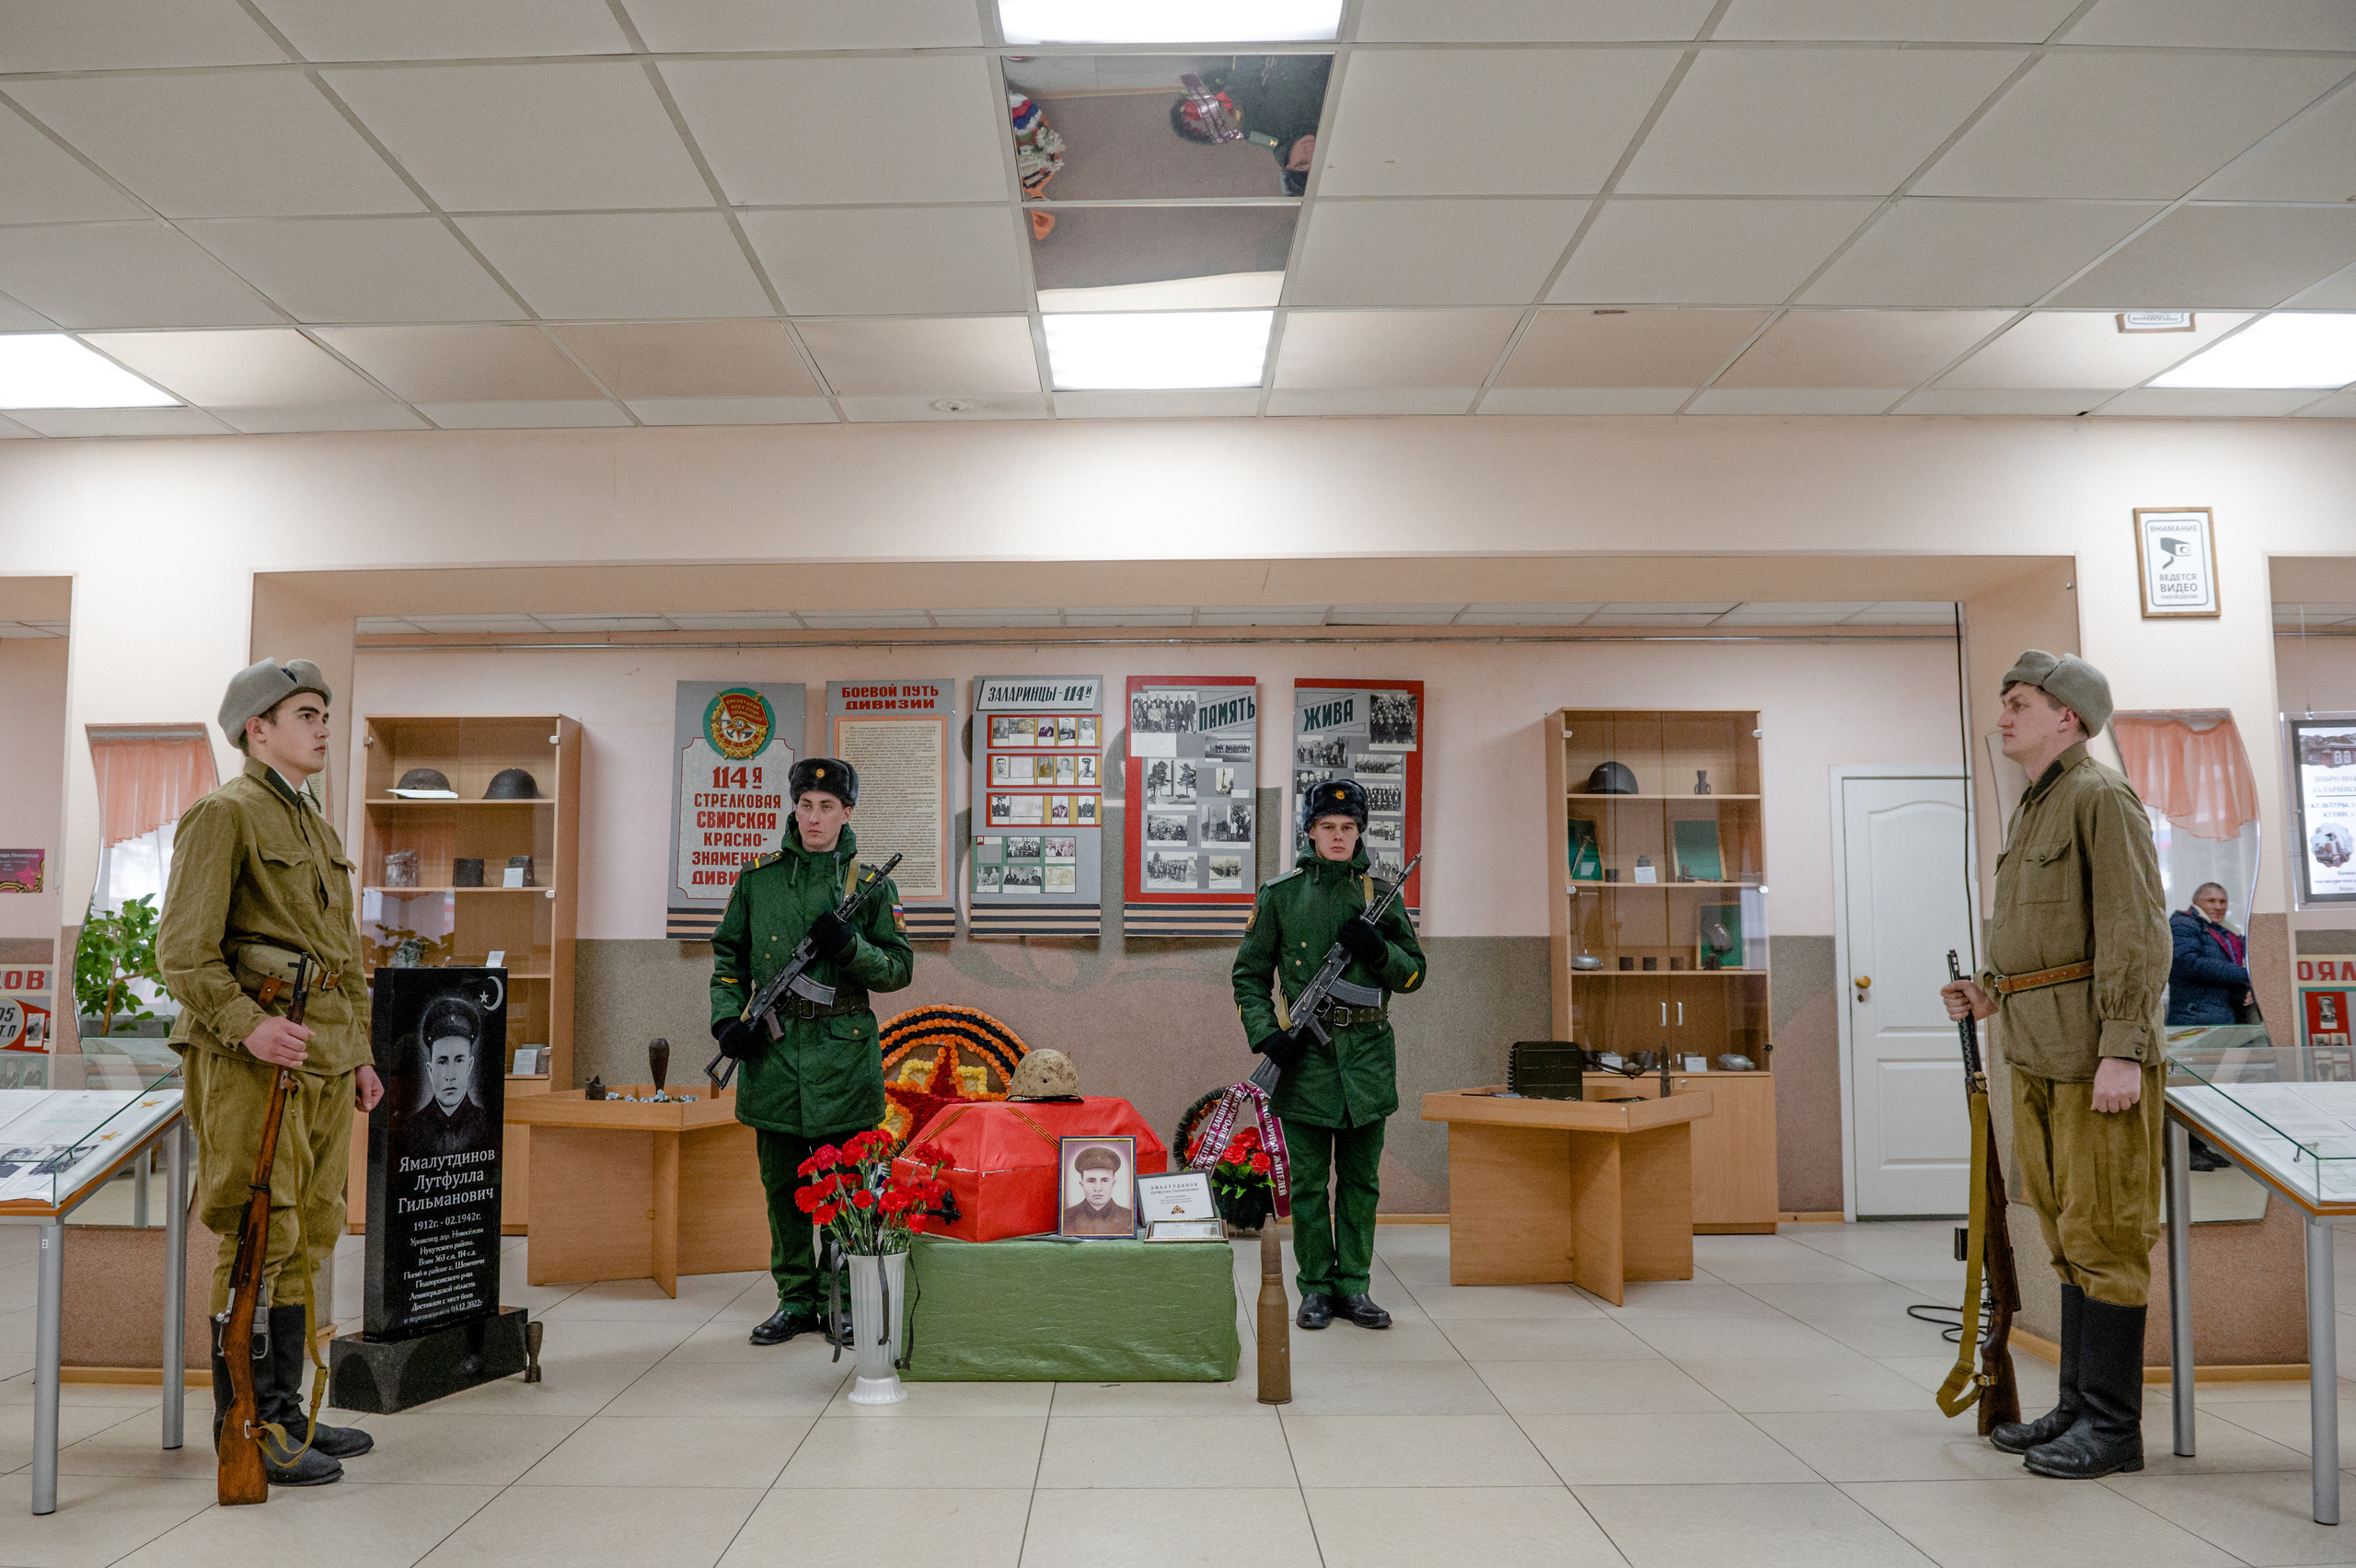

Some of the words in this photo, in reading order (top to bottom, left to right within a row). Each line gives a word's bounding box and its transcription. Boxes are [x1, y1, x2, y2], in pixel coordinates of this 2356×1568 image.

[2150, 525, 2199, 533] ВНИМАНИЕ
[2159, 573, 2198, 582] ВЕДЕТСЯ
[2160, 582, 2198, 594] ВИДЕО
[841, 683, 897, 698] БОЕВОЙ
[902, 685, 939, 698] ПУТЬ
[987, 686, 1057, 703] ЗАЛАРИНЦЫ
[845, 698, 935, 710] ДИВИЗИИ
[1198, 696, 1256, 732] ПАМЯТЬ
[1302, 698, 1354, 732] ЖИВА
[694, 792, 781, 809] СТРЕЛКОВАЯ
[696, 811, 777, 830] СВИРСКАЯ
[703, 832, 768, 847] КРАСНО-
[0, 970, 46, 990] ОВ
[398, 1149, 496, 1173] Ямалутдинов
[413, 1170, 485, 1194] Лутфулла
[1273, 1155, 1288, 1197] ЖИТЕЛЕЙ
[398, 1187, 495, 1214] Гильманович
[413, 1219, 439, 1232] 1912г.
[445, 1212, 481, 1226] 02.1942г.
[434, 1253, 446, 1263] 363
[457, 1250, 467, 1258] 114
[403, 1270, 423, 1280] Погиб
